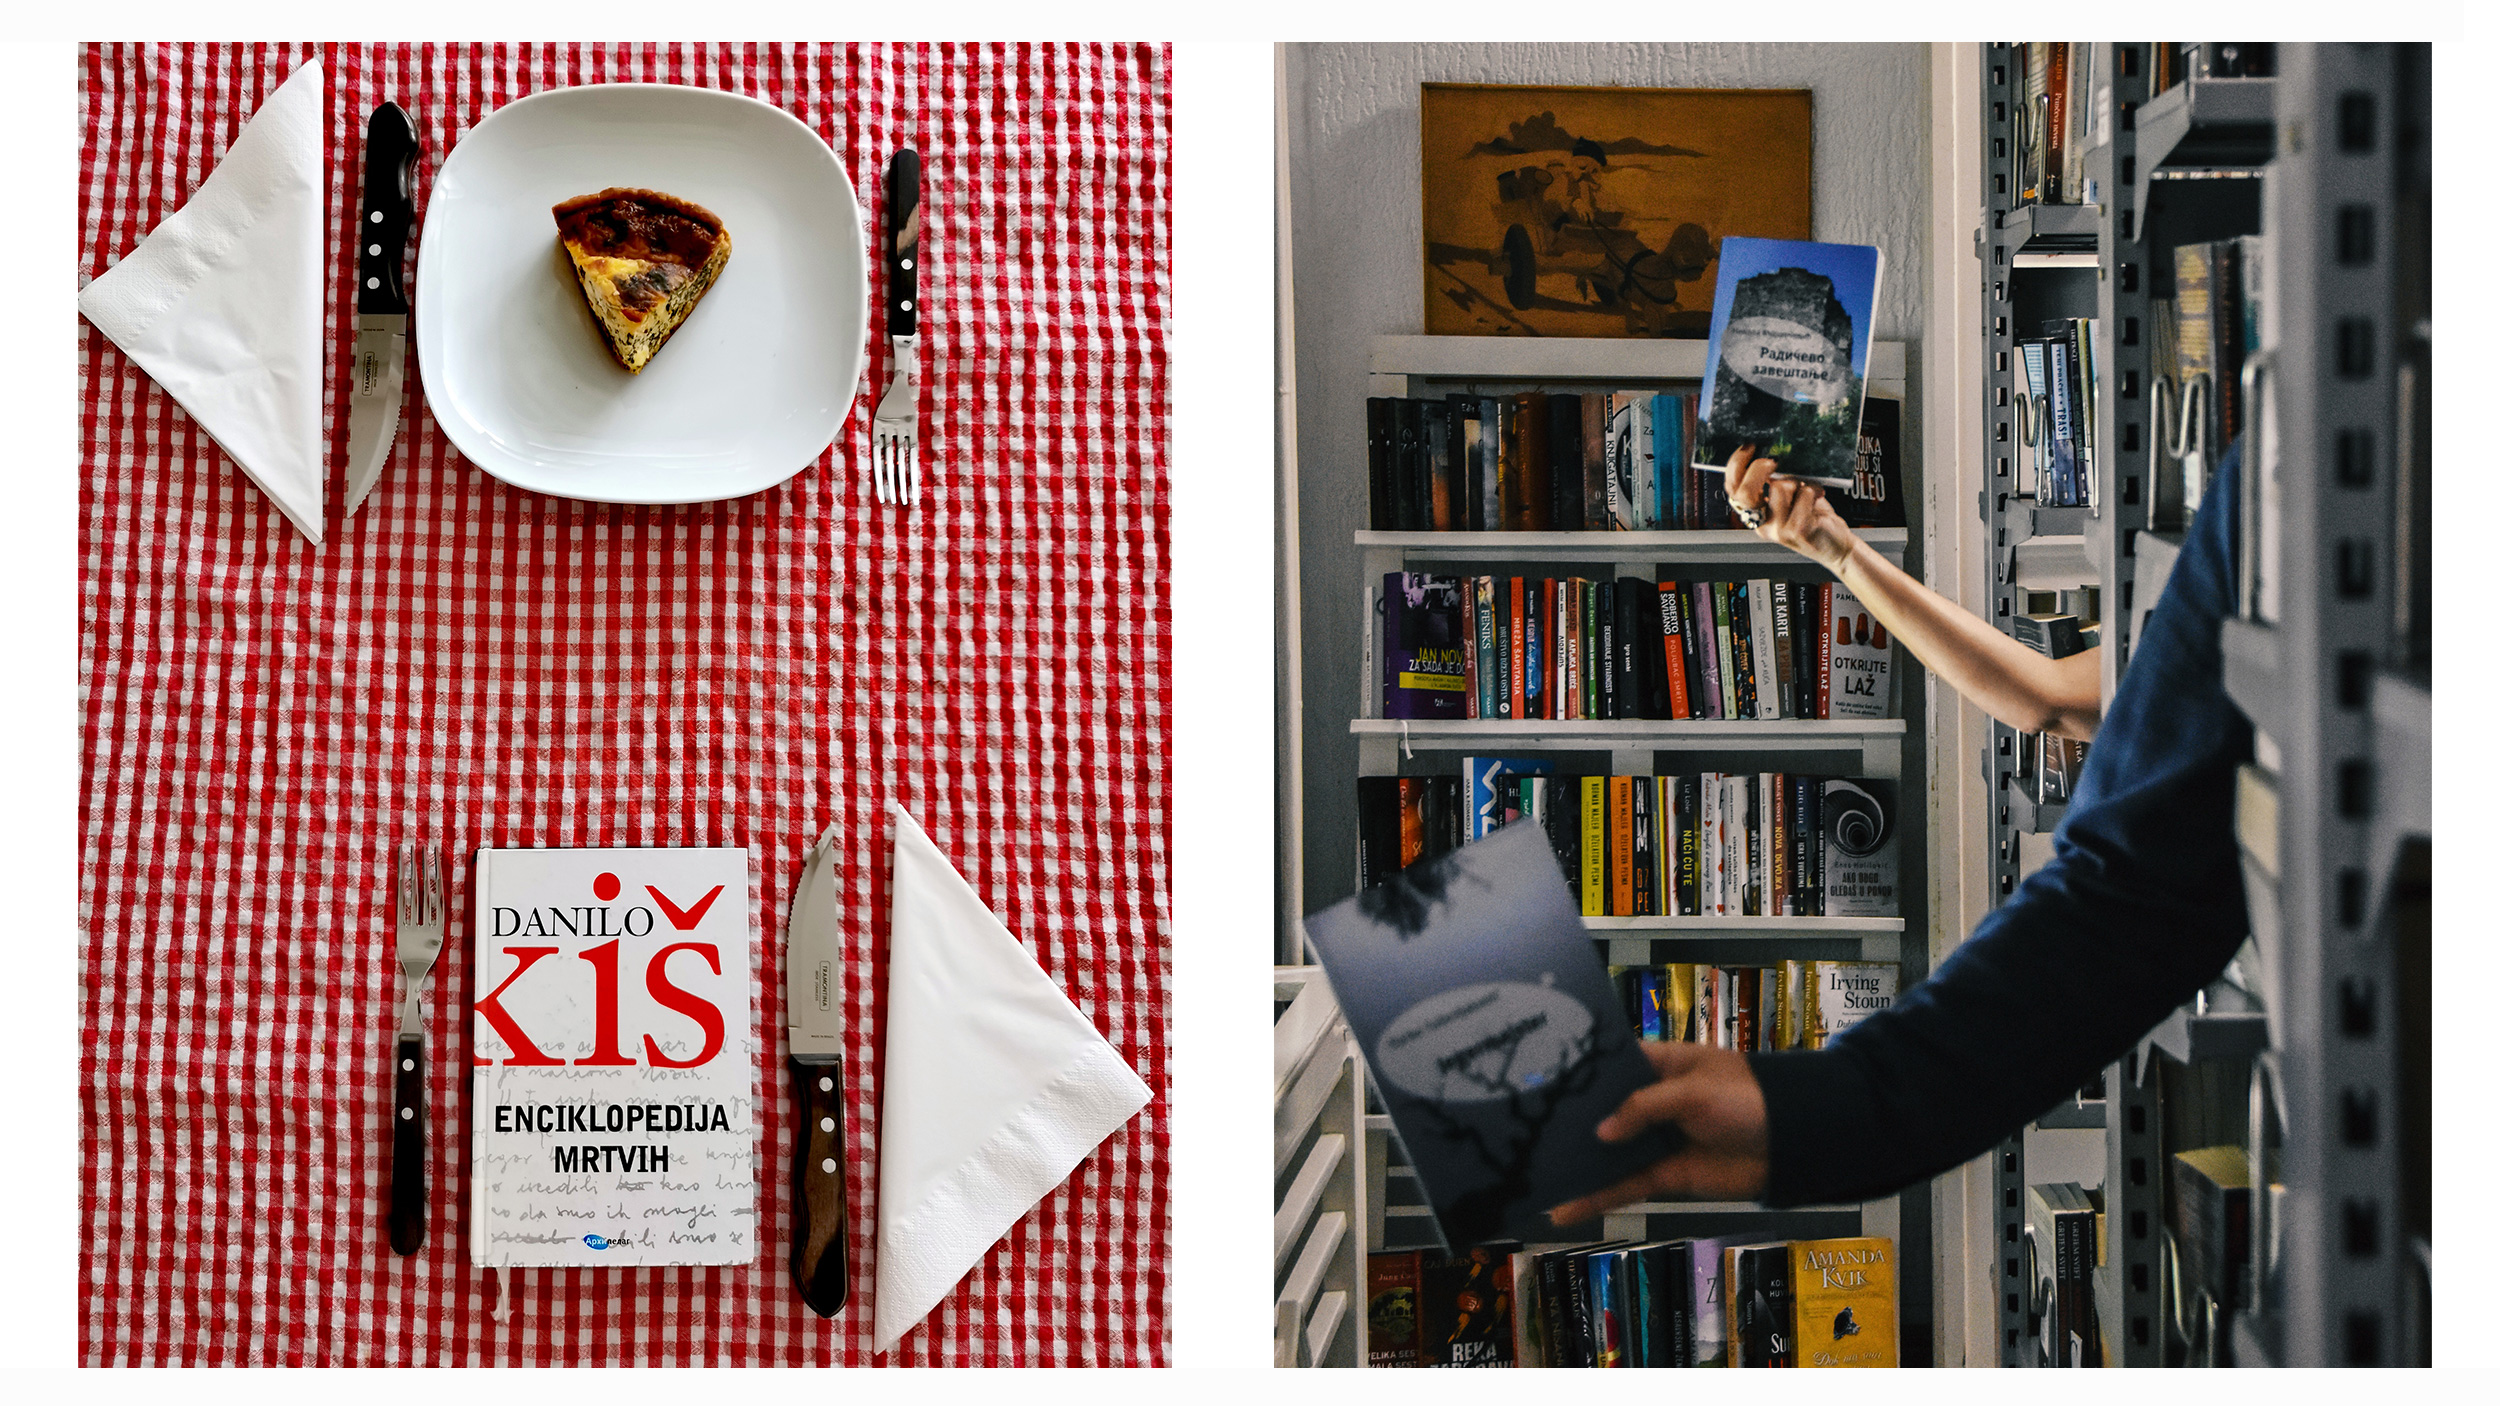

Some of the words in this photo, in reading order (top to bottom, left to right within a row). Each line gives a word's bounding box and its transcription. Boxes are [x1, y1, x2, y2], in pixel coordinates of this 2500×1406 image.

[2054, 93, 2062, 123] Prinčeva
[1760, 346, 1825, 364] Радичево
[2058, 408, 2067, 437] TRAS!
[1607, 440, 1617, 475] KNJIGA
[1607, 475, 1617, 506] TAJNI
[1844, 471, 1886, 502] OLEO
[1775, 583, 1786, 603] DVE
[1660, 593, 1671, 635] SAVIJANO
[1668, 593, 1679, 633] ROBERTO
[1776, 605, 1788, 637] KARTE
[1480, 609, 1492, 650] FENIKS
[1499, 626, 1507, 656] DRUŠTVO
[1513, 617, 1522, 645] MREŽA
[1604, 626, 1612, 660] DEKODIRANJE
[1416, 647, 1437, 665] JAN
[1670, 640, 1679, 677] POLJUBAC
[1821, 632, 1829, 671] OTKRIJTE
[1835, 657, 1887, 674] OTKRIJTE
[1408, 659, 1420, 671] ZA
[1422, 660, 1443, 672] SADA
[1445, 662, 1455, 673] JE
[1513, 648, 1522, 695] ŠAPUTANJA
[1604, 662, 1612, 693] STVARNOSTI
[1820, 674, 1829, 690] LAŽ
[1845, 674, 1875, 697] LAŽ
[1683, 829, 1694, 855] NAĆI
[1774, 826, 1783, 850] NOVA
[1683, 856, 1693, 870] ĆU
[1775, 853, 1783, 890] DEVOJKA
[1683, 873, 1692, 886] TE
[1830, 884, 1857, 897] GLEDAŠ
[1859, 885, 1865, 897] U
[1867, 885, 1893, 897] PONOR
[1842, 872, 1856, 883] AKO
[492, 906, 655, 937] DANILO
[1777, 970, 1785, 999] Irving
[1805, 970, 1813, 999] Irving
[1831, 973, 1880, 995] Irving
[1844, 991, 1890, 1009] Stoun
[494, 1104, 730, 1133] ENCIKLOPEDIJA
[554, 1145, 669, 1173] MRTVIH
[1804, 1249, 1885, 1270] AMANDA
[2058, 1256, 2066, 1280] SVIFT
[2073, 1256, 2081, 1280] SVIFT
[1568, 1259, 1578, 1290] TIFANI
[1822, 1267, 1870, 1290] KVIK
[1674, 1310, 1683, 1352] NESAVRŠENE
[1452, 1341, 1498, 1362] REKA
